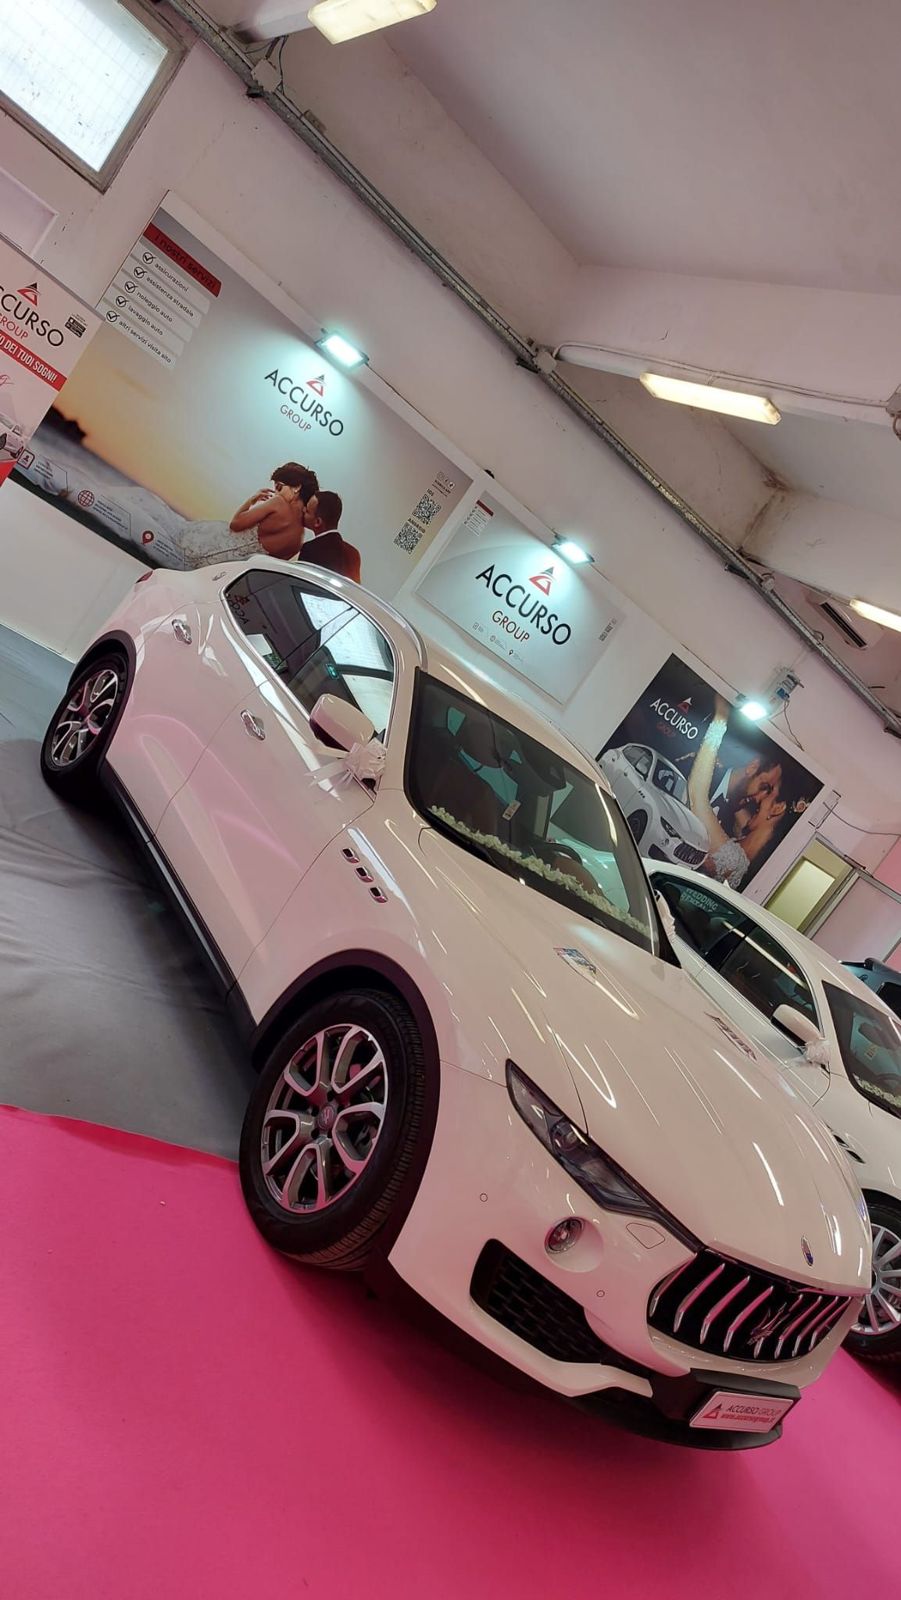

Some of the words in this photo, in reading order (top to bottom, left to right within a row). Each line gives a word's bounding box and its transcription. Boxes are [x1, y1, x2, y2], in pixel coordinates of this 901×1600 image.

[154, 263, 190, 292] assicurazioni
[160, 239, 187, 264] nostri
[188, 262, 216, 290] servizi
[137, 291, 160, 313] noleggio
[160, 310, 173, 323] auto
[146, 276, 173, 301] assistenza
[173, 298, 194, 317] stradale
[128, 305, 151, 327] lavaggio
[150, 323, 163, 336] auto
[4, 340, 18, 354] DEI
[17, 348, 33, 365] TUOI
[119, 319, 131, 332] altri
[130, 327, 148, 344] servizi
[147, 342, 162, 357] visita
[161, 352, 172, 363] sito
[264, 368, 344, 436] ACCURSO
[280, 404, 312, 432] GROUP
[475, 564, 572, 645] ACCURSO
[492, 610, 530, 643] GROUP
[650, 698, 699, 739] ACCURSO
[686, 888, 718, 910] WEDDING
[726, 1404, 760, 1415] ACCURSO
